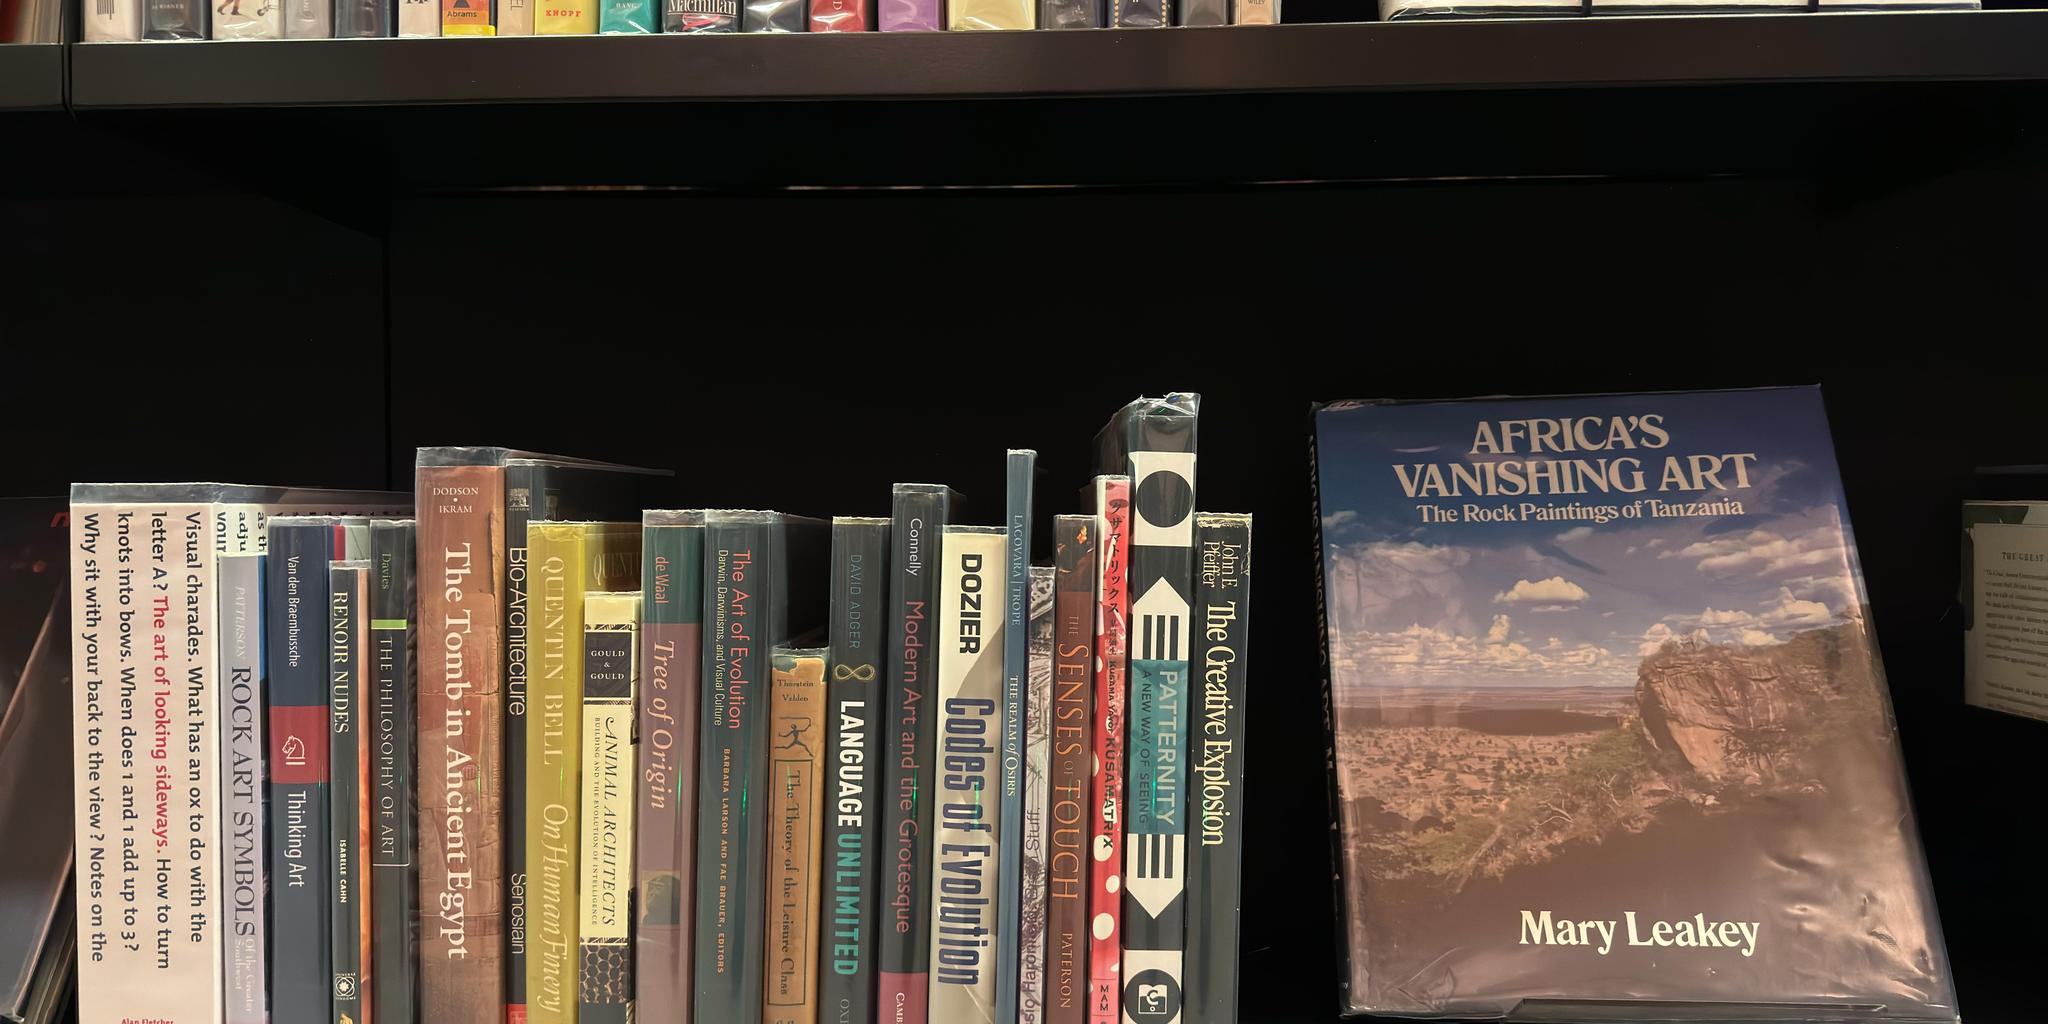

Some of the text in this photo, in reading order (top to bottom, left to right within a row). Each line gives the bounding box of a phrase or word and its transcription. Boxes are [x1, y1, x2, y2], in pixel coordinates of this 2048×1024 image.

[447, 10, 477, 18] Abrams
[1392, 453, 1758, 499] VANISHING ART
[1469, 414, 1670, 456] AFRICA'S
[258, 512, 265, 530] as
[433, 487, 479, 496] DODSON
[439, 505, 473, 513] IKRAM
[1417, 497, 1745, 524] The Rock Paintings of Tanzania
[287, 556, 301, 667] Van den Braembussche
[381, 552, 392, 590] Davies
[655, 556, 670, 604] de Waal
[848, 554, 863, 649] DAVID ADGER
[959, 553, 983, 654] DOZIER
[1202, 541, 1221, 588] Pfeiffer
[1220, 540, 1241, 589] John E.
[333, 591, 350, 734] RENOIR NUDES
[590, 649, 625, 657] GOULD
[590, 672, 625, 680] GOULD
[713, 549, 729, 726] Darwin, Darwinisms, and Visual Culture
[728, 549, 751, 729] The Art of Evolution
[1005, 514, 1023, 797] LACOVARA TROPE THE REALM of OSIRIS
[1068, 615, 1079, 636] THE
[186, 512, 206, 943] Visual charades. What has an ox to do with the
[380, 636, 394, 858] THE PHILOSOPHY OF ART
[439, 542, 473, 960] The Tomb in Ancient Egypt
[509, 547, 527, 954] Bio-Architecture Senosiain
[645, 640, 675, 809] Tree of Origin
[890, 518, 925, 934] Connelly Modern Art and the Grotesque
[1055, 643, 1090, 757] SENSES
[1138, 670, 1152, 824] A NEW WAY OF SEEING
[1155, 670, 1178, 826] PATTERNITY
[1194, 601, 1237, 846] The Creative Explosion
[231, 583, 256, 937] PATTERSON ROCK ART SYMBOLS
[537, 556, 569, 1013] QUENTIN BELL On Human Finery
[1103, 737, 1116, 849] KUSAMATRIX
[284, 790, 307, 888] Thinking Art
[339, 839, 347, 876] ISABELLE
[592, 800, 600, 848] EVOLUTION
[592, 851, 599, 861] OF
[602, 716, 619, 926] ANIMAL ARCHITECTS
[716, 748, 731, 974] BARBARA LARSON AND FAE BRAUER, EDITORS
[833, 700, 865, 975] LANGUAGE UNLIMITED
[937, 697, 996, 986] Codes of Evolution
[1051, 779, 1082, 900] TOUCH
[591, 864, 599, 925] INTELLIGENCE
[779, 770, 801, 995] The Theory of the Leisure Class
[1519, 909, 1760, 957] Mary Leakey
[1059, 932, 1073, 1009] PATERSON
